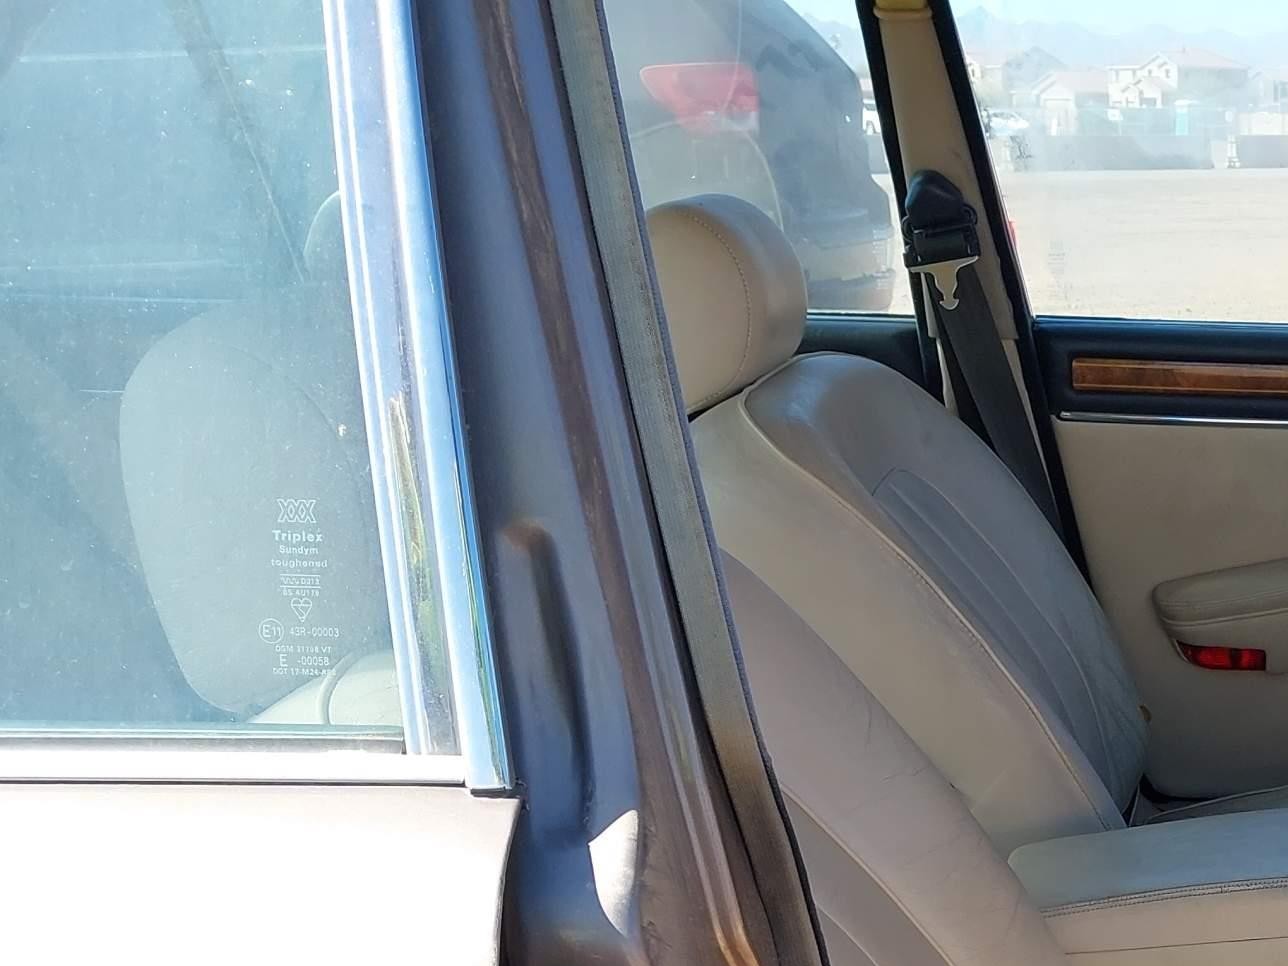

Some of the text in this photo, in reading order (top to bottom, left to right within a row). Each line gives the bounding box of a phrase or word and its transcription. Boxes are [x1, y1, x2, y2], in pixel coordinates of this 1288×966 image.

[271, 529, 323, 544] Triplex
[278, 544, 319, 556] Sundym
[270, 557, 328, 569] toughened
[279, 654, 288, 667] E
